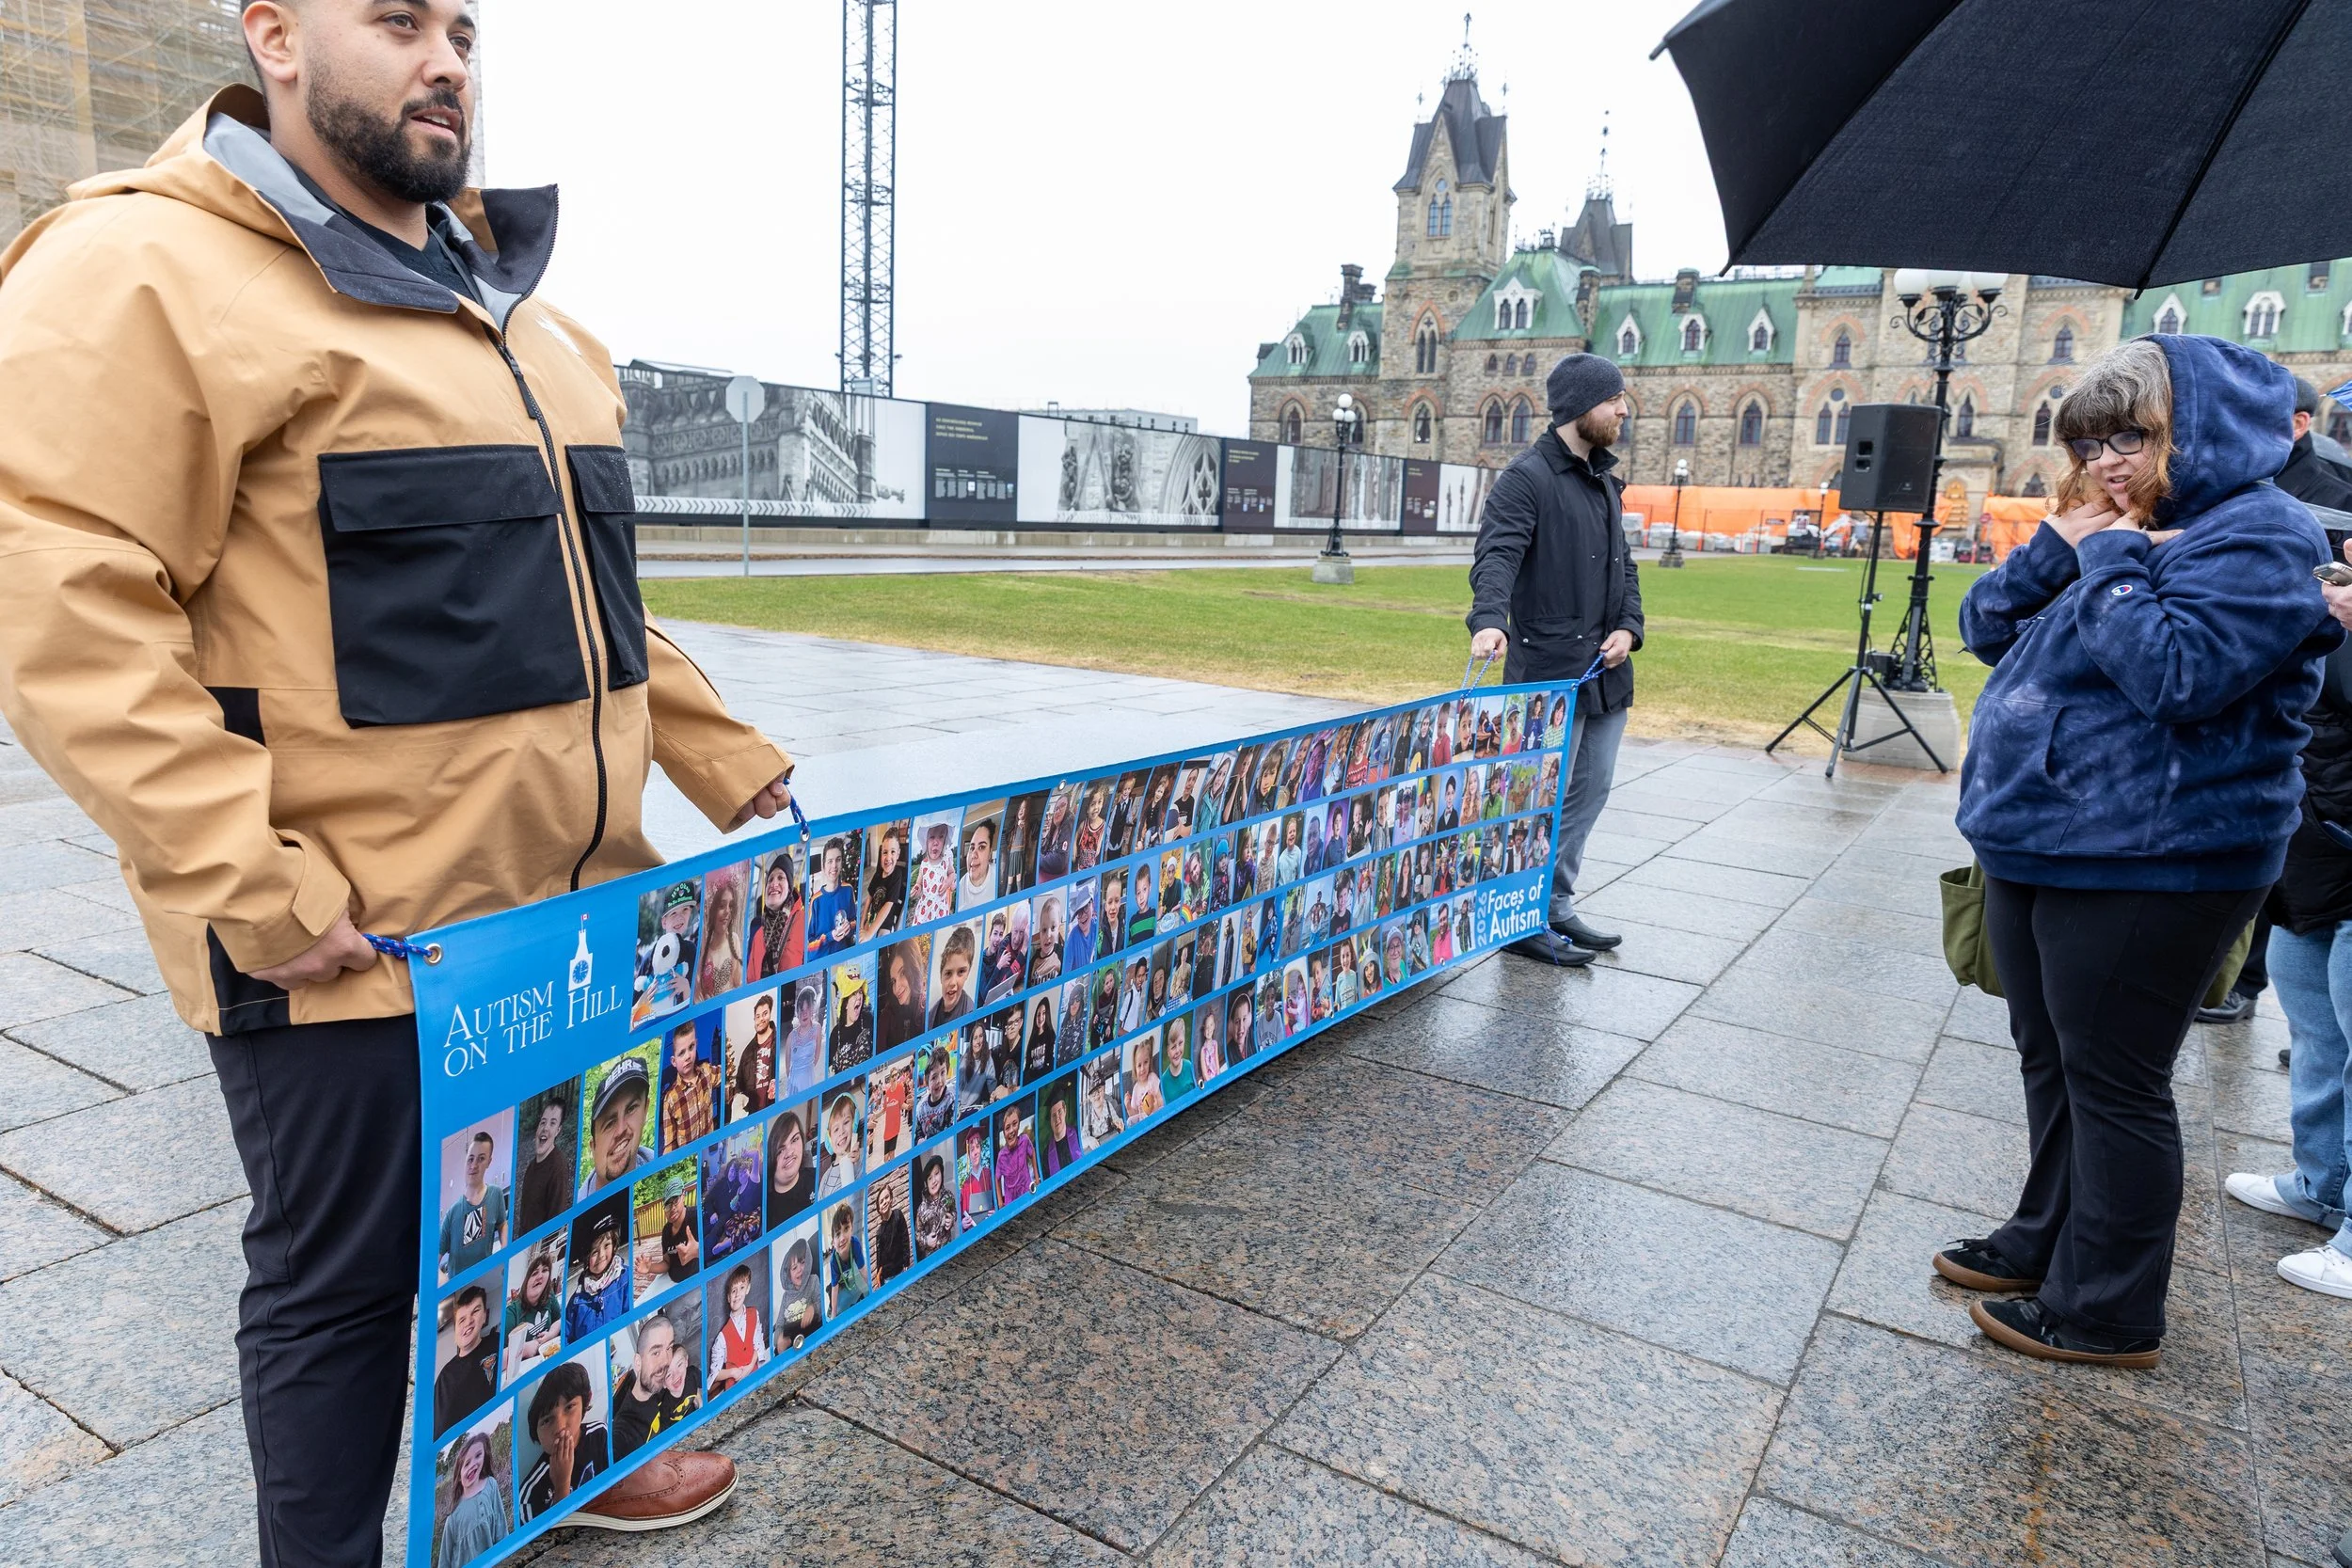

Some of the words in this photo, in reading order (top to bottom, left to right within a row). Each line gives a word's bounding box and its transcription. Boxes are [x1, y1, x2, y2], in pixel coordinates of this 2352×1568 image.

[1476, 891, 1486, 947] 2026
[1487, 889, 1524, 914] Faces
[1528, 874, 1545, 901] of
[1489, 905, 1540, 942] Autism
[443, 980, 555, 1048] AUTISM
[444, 1037, 488, 1077] ON
[502, 1011, 554, 1054] THE
[566, 985, 623, 1029] HILL
